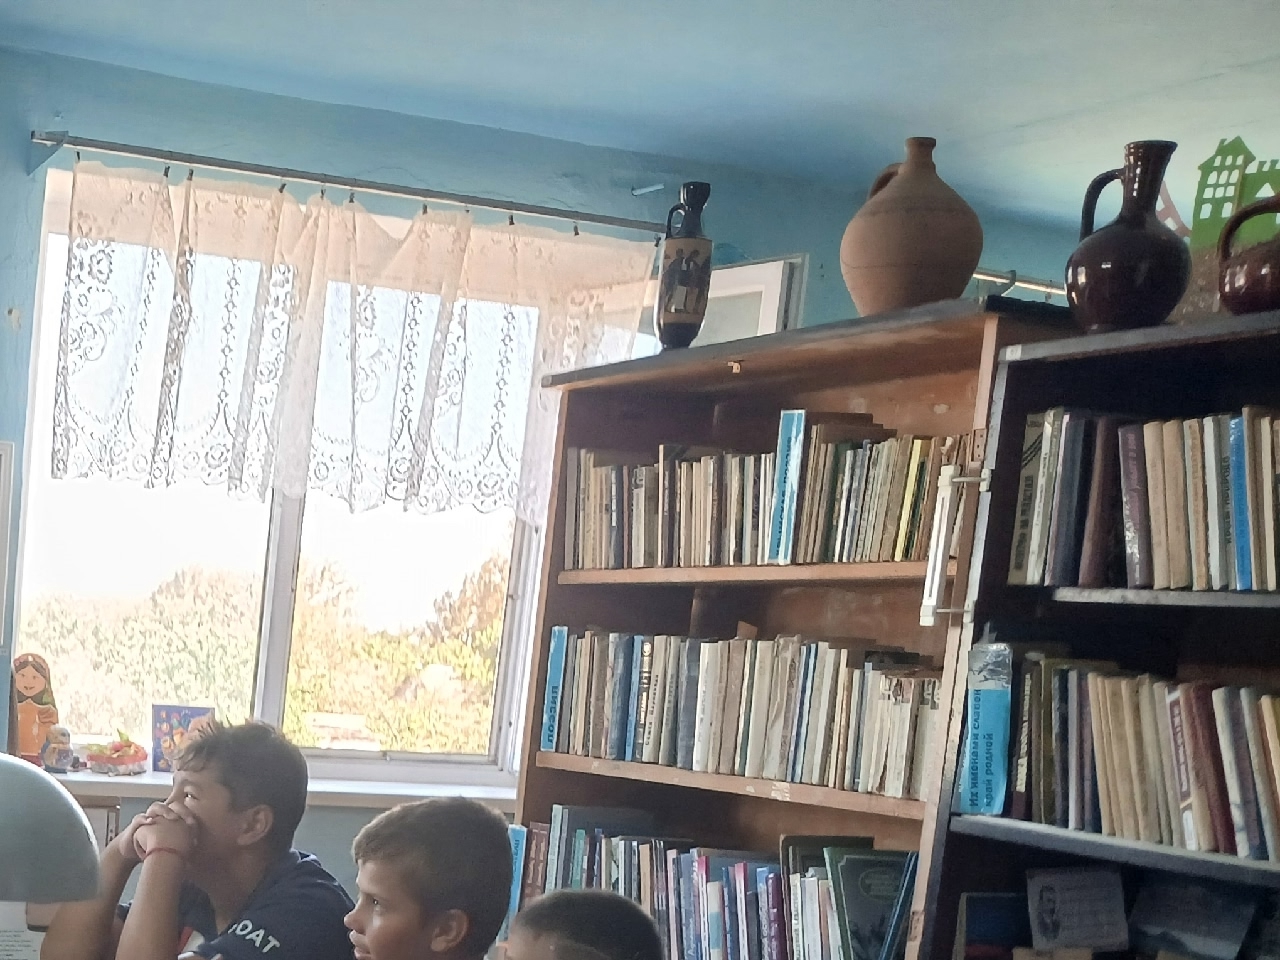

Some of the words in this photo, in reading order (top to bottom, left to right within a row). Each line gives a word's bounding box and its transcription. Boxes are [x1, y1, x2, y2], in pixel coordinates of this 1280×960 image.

[972, 689, 982, 730] славен
[983, 732, 994, 776] родной
[969, 791, 979, 807] Их
[983, 779, 994, 807] край
